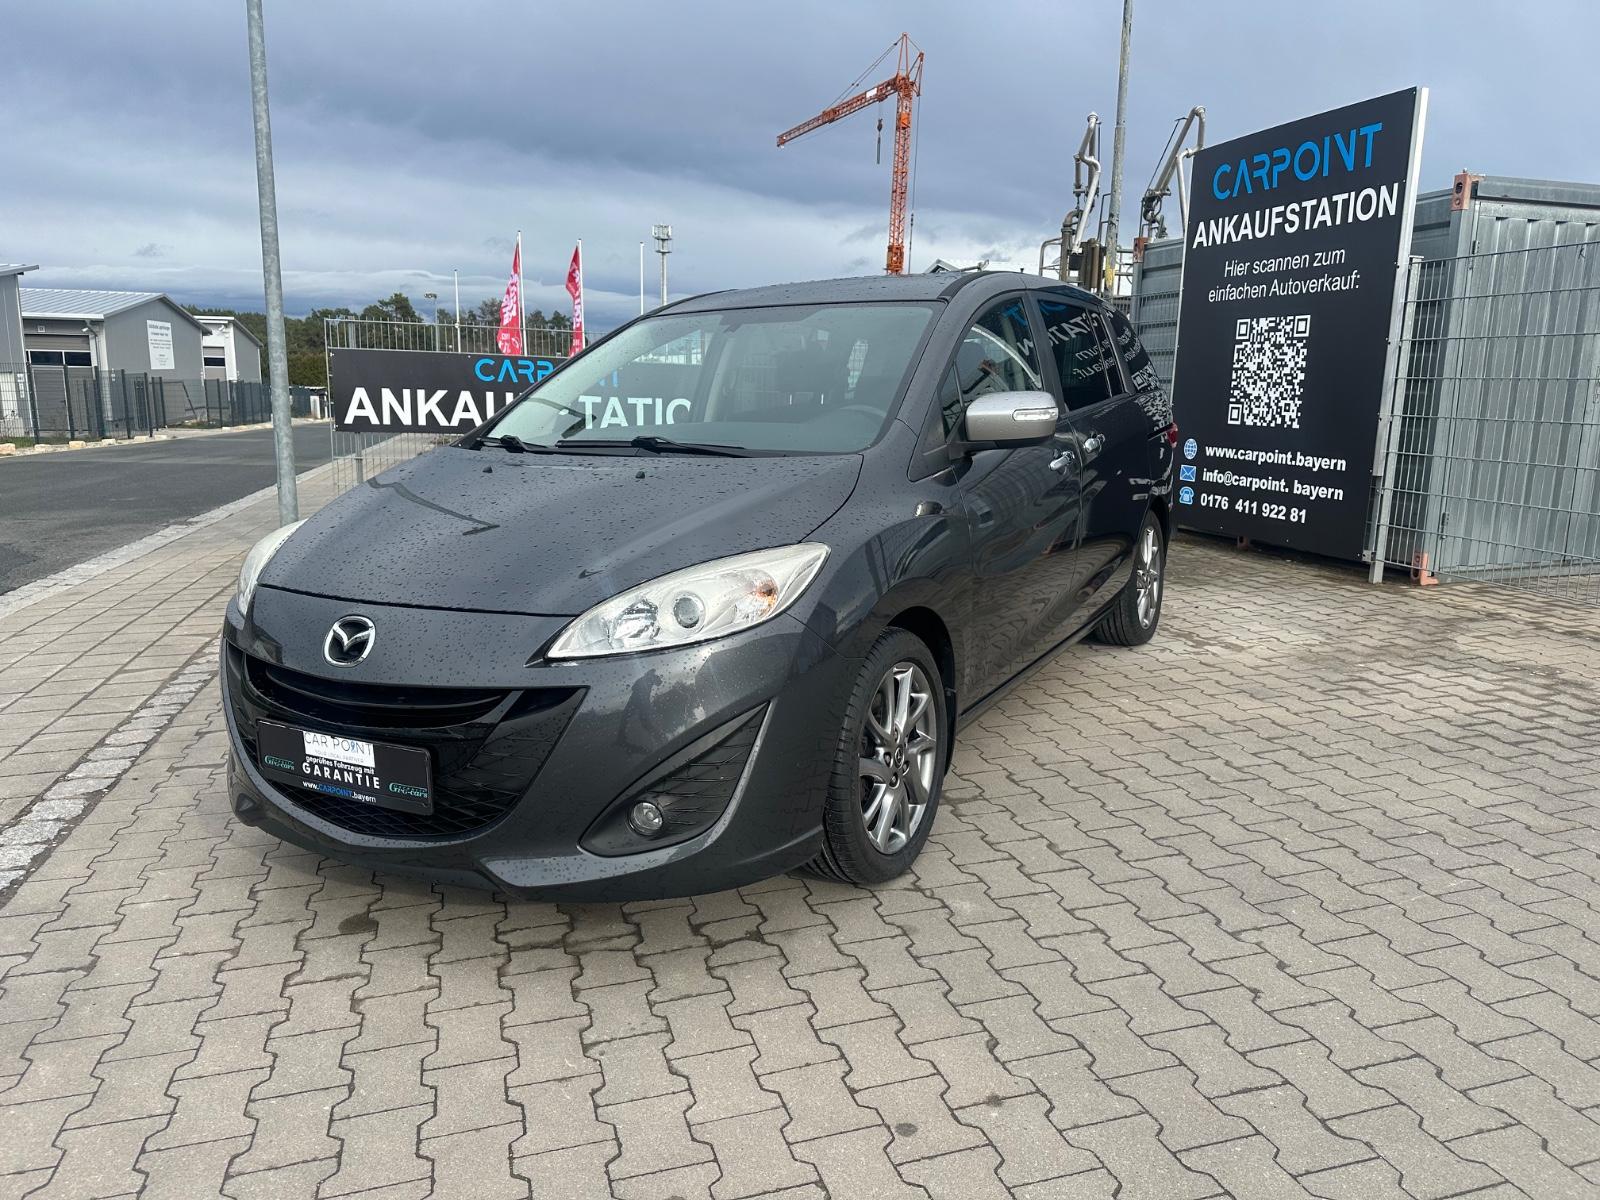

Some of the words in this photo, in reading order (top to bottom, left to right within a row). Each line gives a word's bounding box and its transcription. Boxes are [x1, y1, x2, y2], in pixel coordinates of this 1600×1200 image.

[1212, 122, 1383, 200] CARPOINT
[1192, 182, 1399, 249] ANKAUFSTATION
[1224, 260, 1250, 278] Hier
[1252, 254, 1309, 274] scannen
[1313, 248, 1346, 267] zum
[1208, 282, 1267, 303] einfachen
[1269, 269, 1361, 297] Autoverkauf:
[1205, 445, 1347, 471] www.carpoint.bayern
[1202, 468, 1289, 493] info@carpoint.
[1293, 479, 1344, 501] bayern
[1200, 493, 1229, 510] 0176
[1235, 498, 1258, 515] 411
[1261, 502, 1287, 520] 922
[1290, 507, 1307, 524] 81
[305, 732, 328, 748] CAR
[302, 762, 380, 789] GARANTIE
[302, 780, 377, 803] www.CARPOINT.bayern
